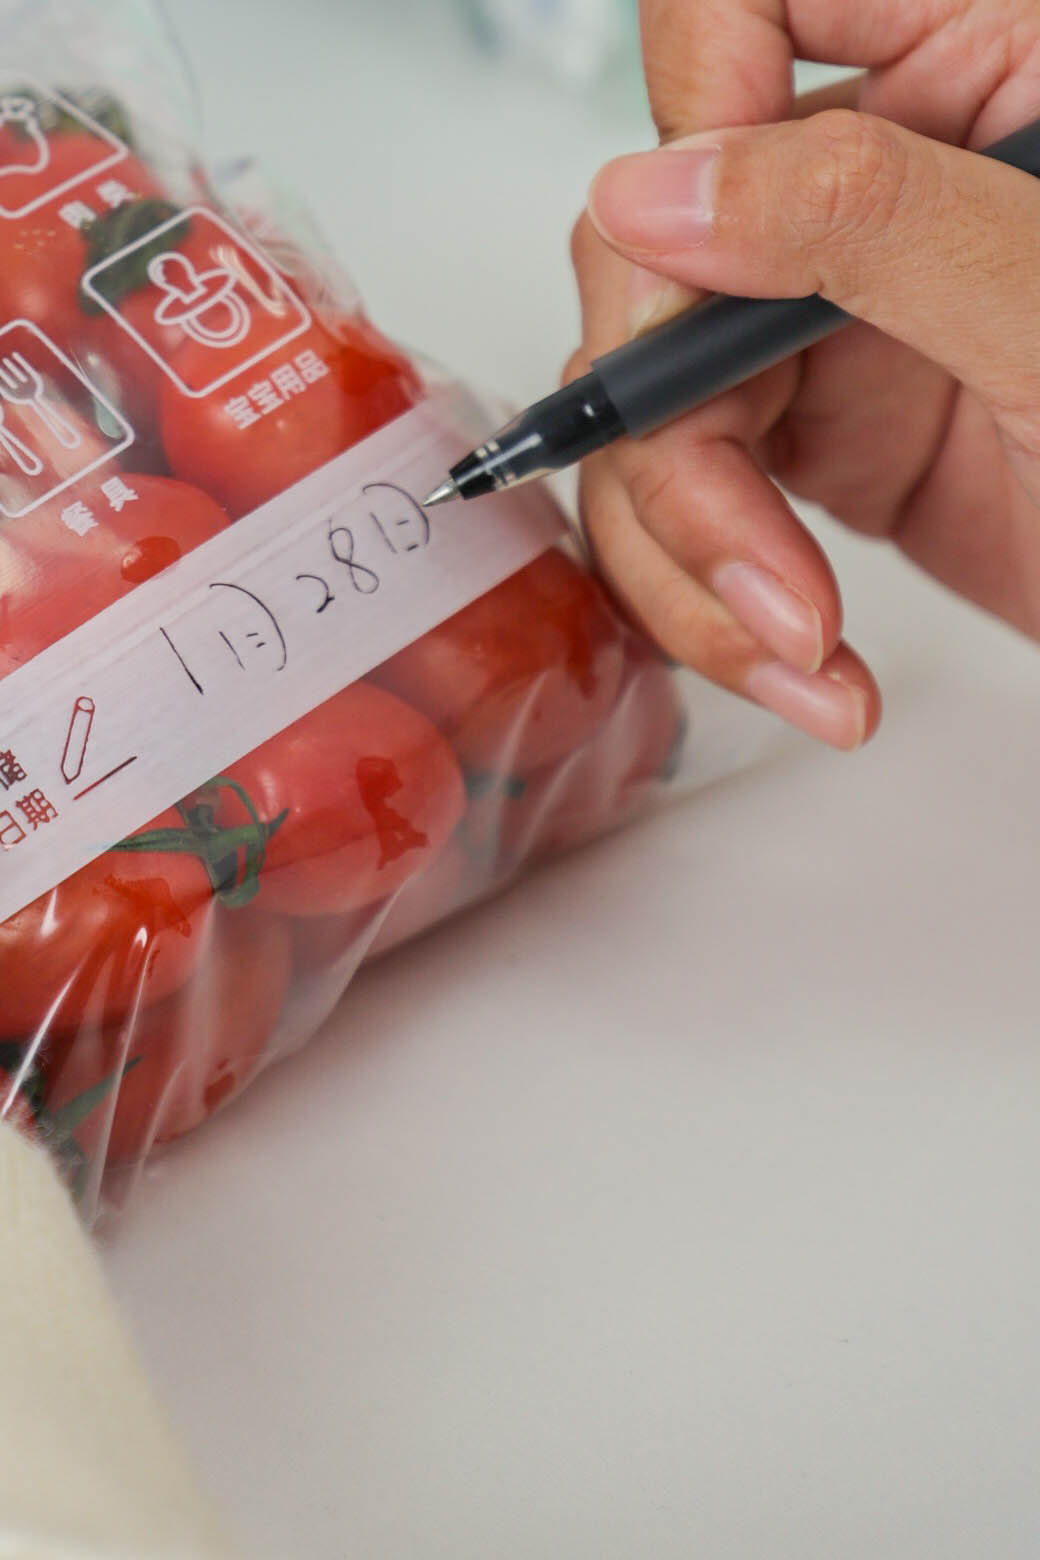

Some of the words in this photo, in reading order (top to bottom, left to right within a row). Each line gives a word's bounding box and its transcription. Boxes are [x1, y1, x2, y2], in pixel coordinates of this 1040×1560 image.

[223, 348, 330, 430] 宝宝用品
[61, 476, 139, 536] 餐具
